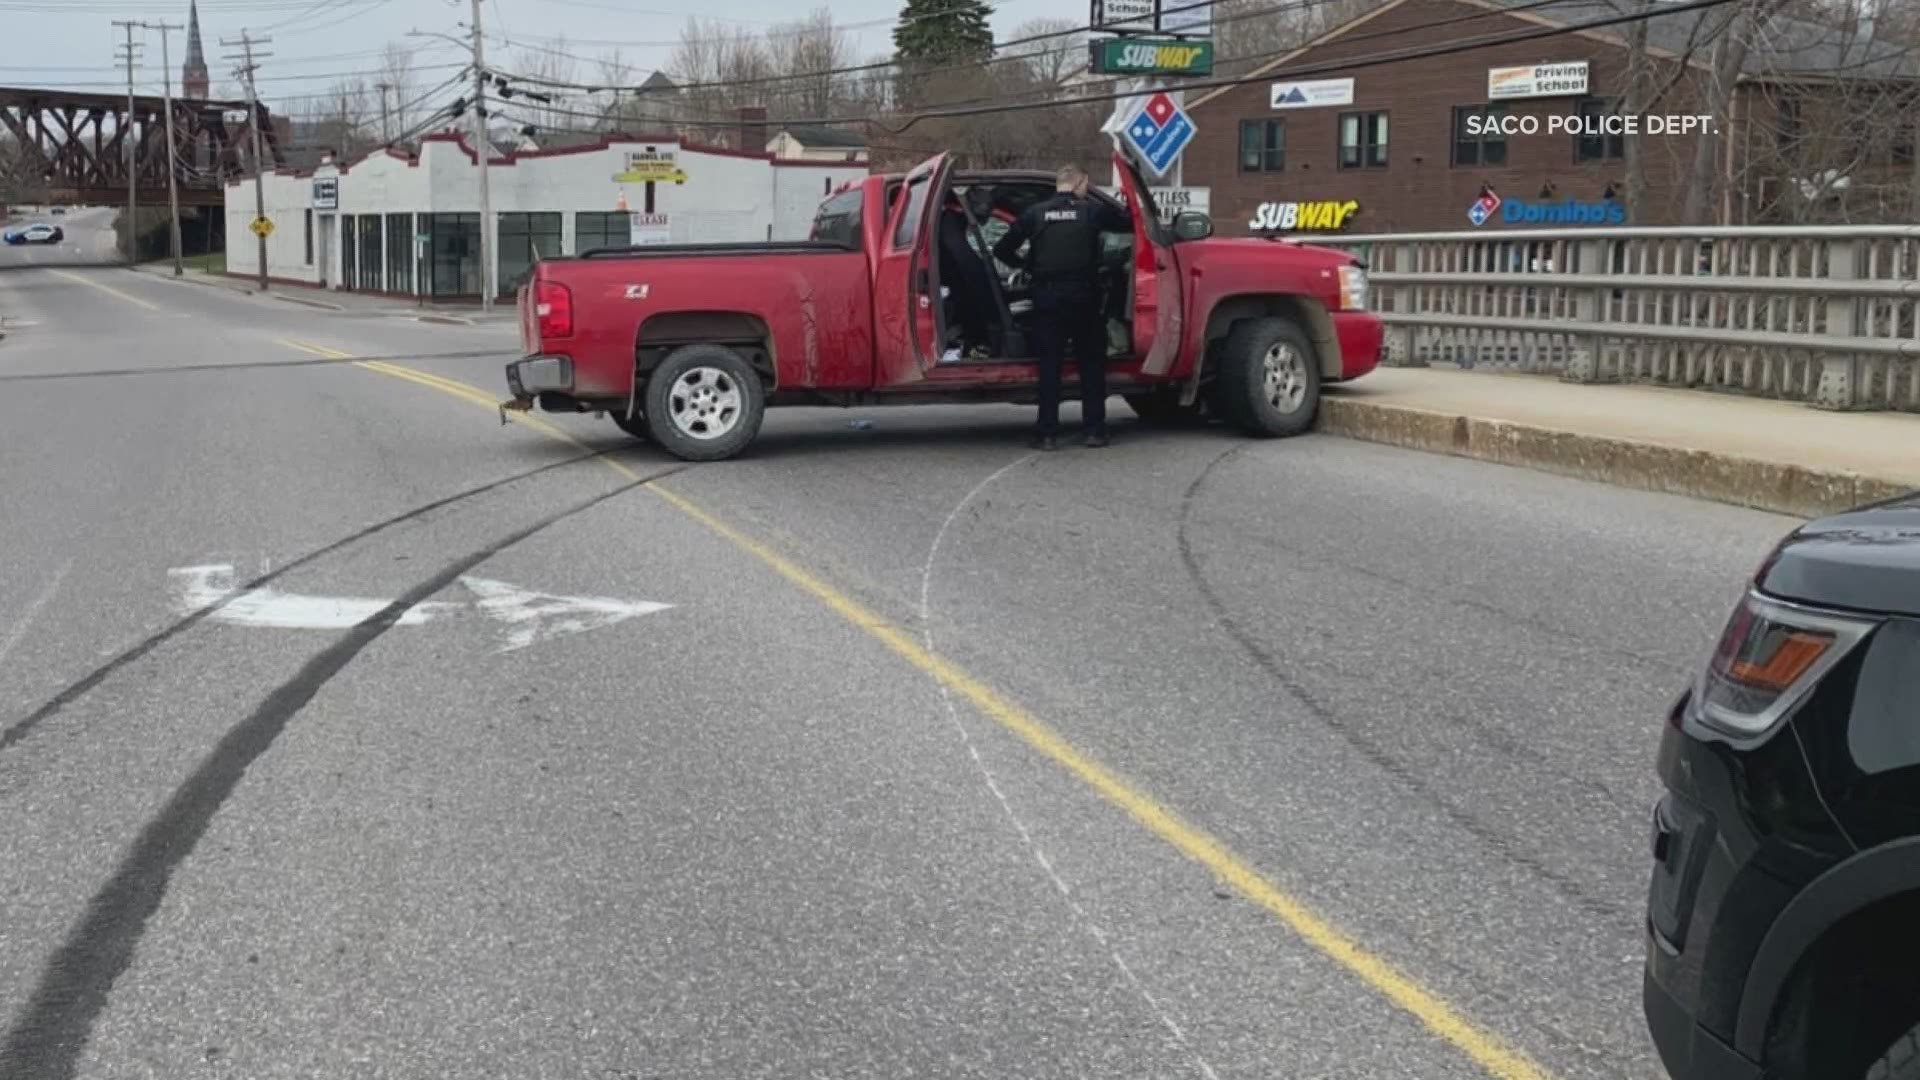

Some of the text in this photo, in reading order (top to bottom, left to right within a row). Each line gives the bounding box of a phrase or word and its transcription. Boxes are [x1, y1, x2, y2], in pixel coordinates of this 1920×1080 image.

[1107, 3, 1151, 12] School
[1116, 44, 1203, 69] SUBWAY
[1535, 66, 1586, 79] Driving
[1536, 79, 1585, 92] School
[1114, 191, 1191, 204] COCTLESS
[1044, 209, 1078, 221] POLICE
[1248, 199, 1359, 230] SUBWAY
[1502, 197, 1625, 224] Domino's
[640, 214, 668, 225] LEASE
